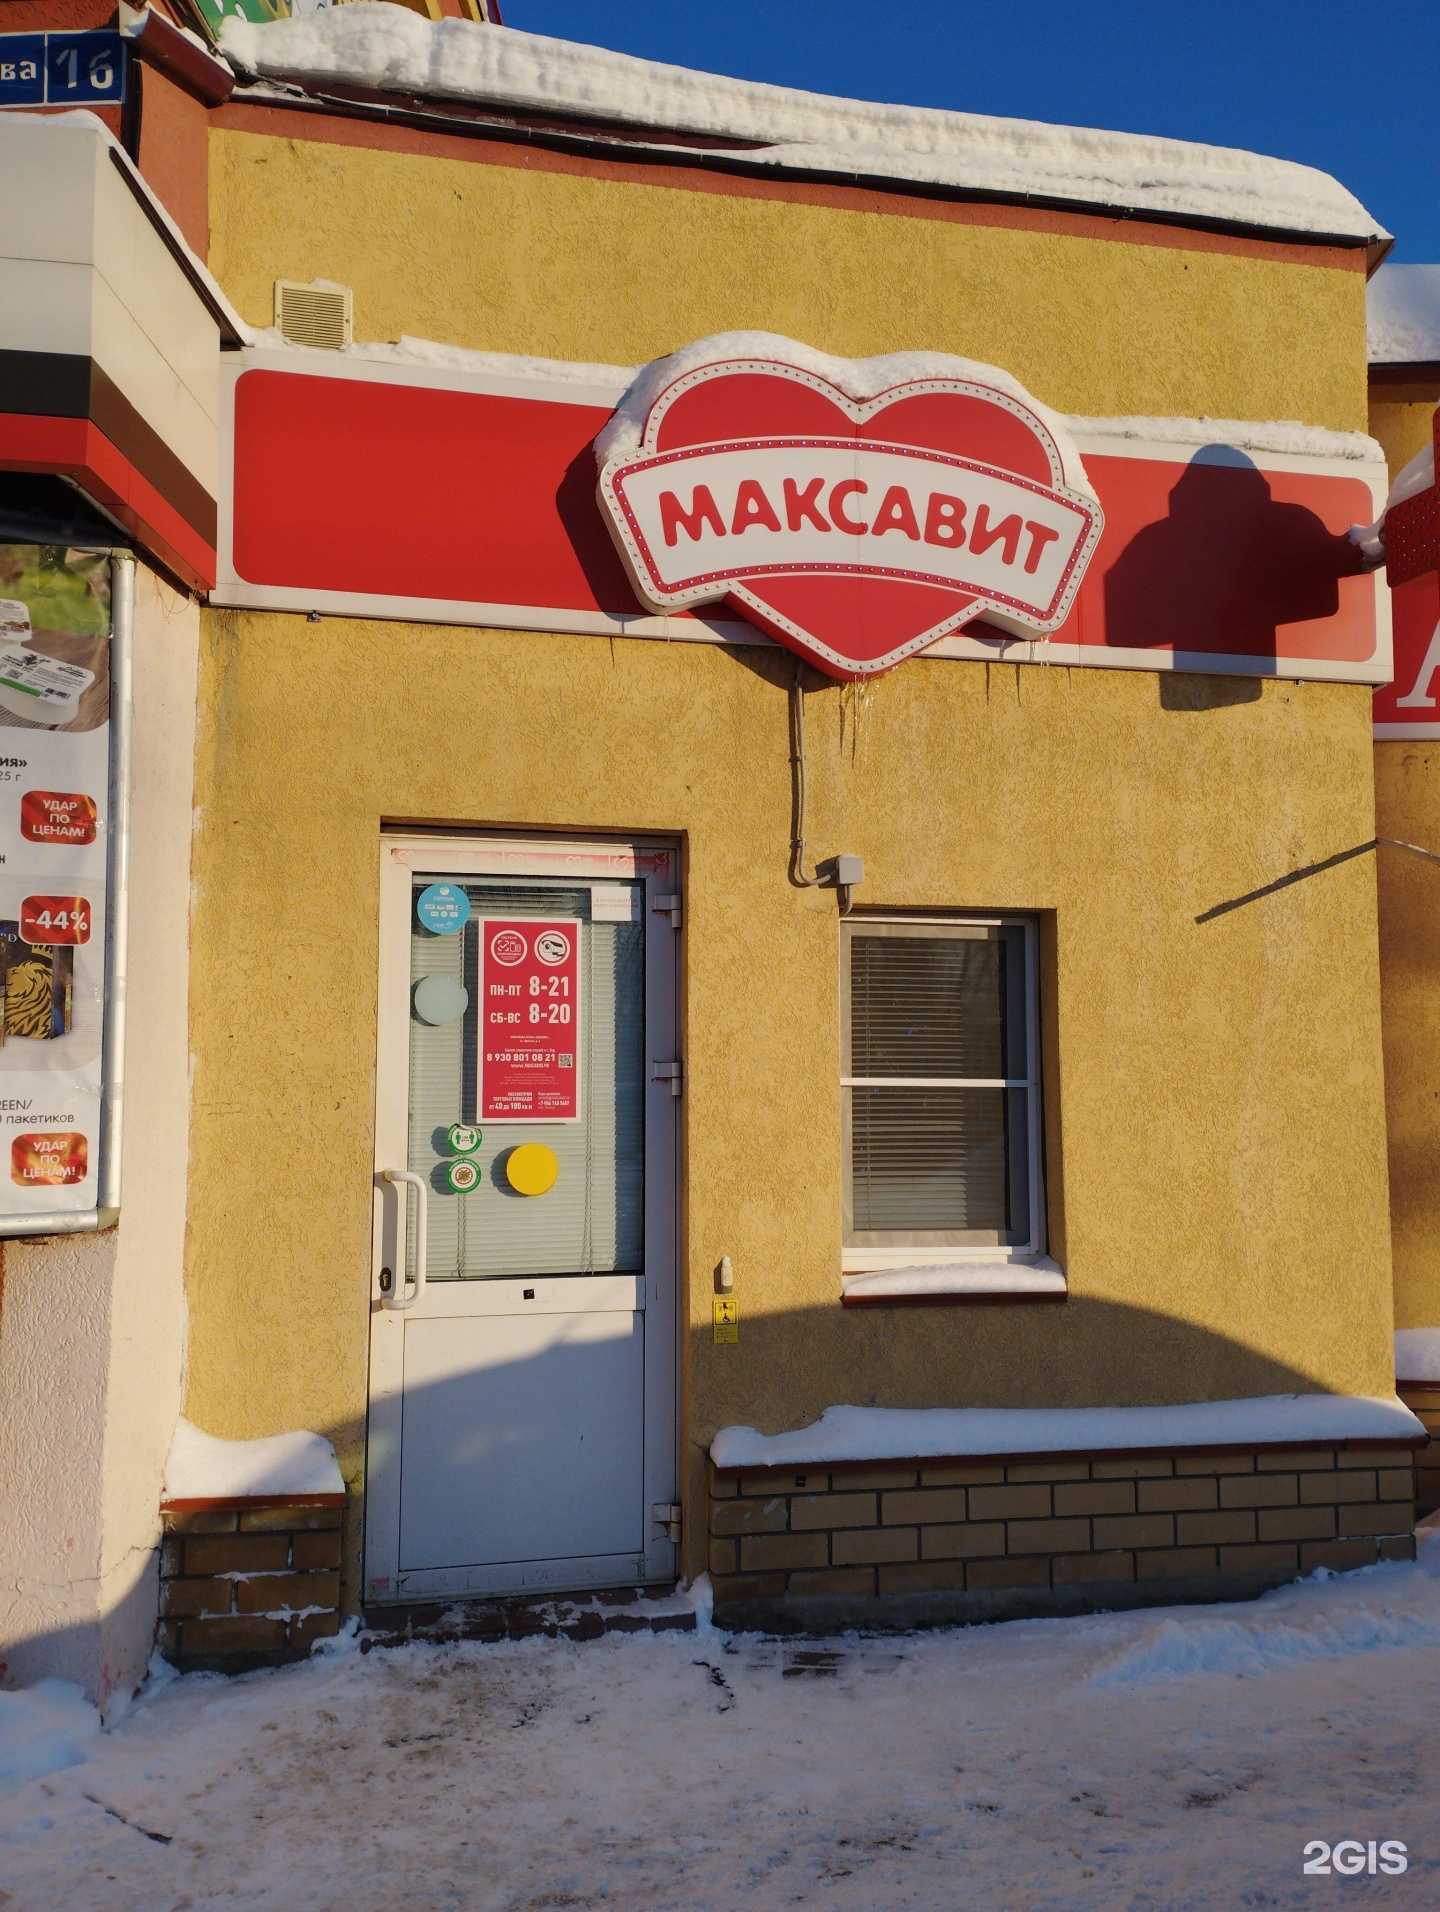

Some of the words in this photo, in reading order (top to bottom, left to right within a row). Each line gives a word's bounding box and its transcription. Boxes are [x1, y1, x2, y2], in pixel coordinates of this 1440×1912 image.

[0, 60, 37, 80] ва
[659, 477, 1060, 575] МАКСАВИТ
[42, 799, 78, 811] УДАР
[49, 812, 71, 824] ПО
[32, 824, 86, 837] ЦЕНАМ!
[24, 910, 88, 931] -44%
[490, 984, 522, 996] ПН-ПТ
[529, 975, 569, 997] 8-21
[490, 1012, 521, 1024] СБ-ВС
[529, 1002, 571, 1024] 8-20
[486, 1053, 493, 1062] 8
[494, 1053, 511, 1062] 930
[545, 1053, 556, 1062] 21
[6, 1113, 75, 1125] пакетиков
[33, 1140, 69, 1152] УДАР
